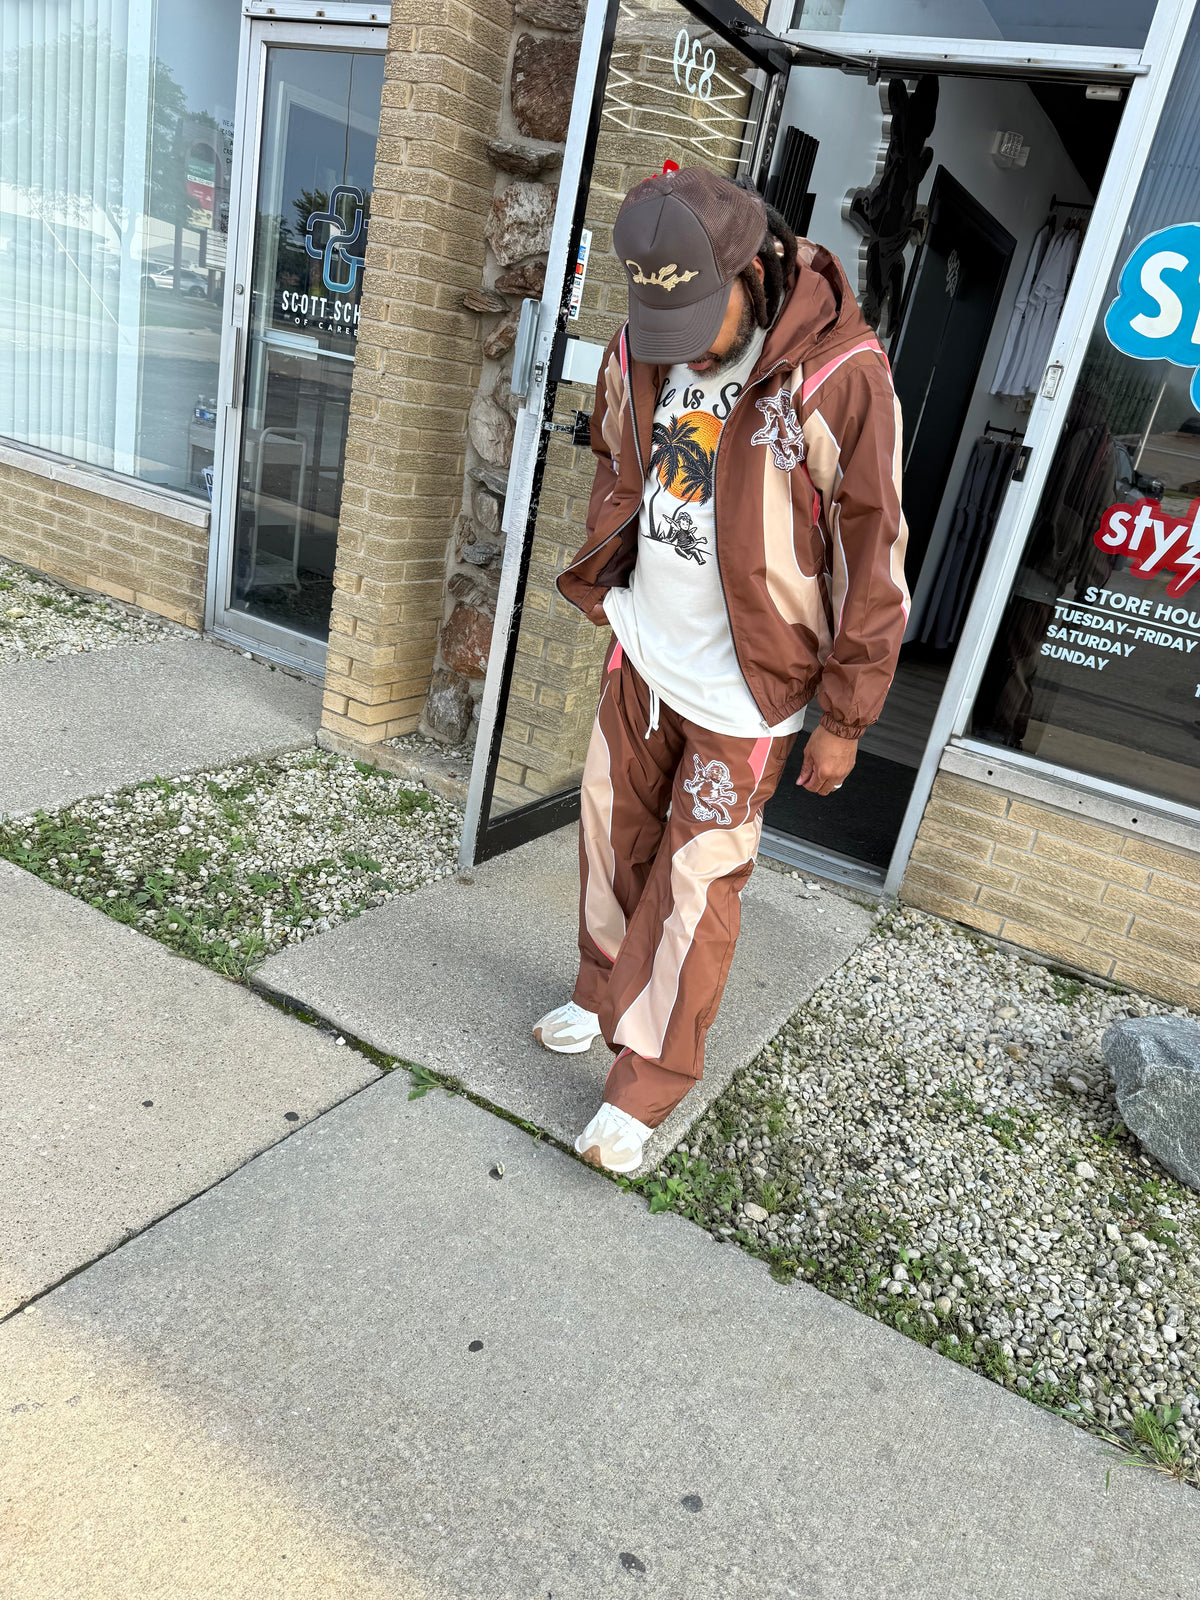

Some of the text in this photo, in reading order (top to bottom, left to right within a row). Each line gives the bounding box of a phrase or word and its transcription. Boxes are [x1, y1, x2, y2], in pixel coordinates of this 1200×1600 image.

[281, 290, 360, 324] SCOTT SCH
[1129, 250, 1200, 345] S
[294, 317, 358, 337] OF CAREE
[682, 383, 705, 410] is
[1084, 586, 1200, 628] STORE HOU
[1046, 624, 1136, 658] SATURDAY
[1054, 605, 1199, 653] TUESDAY-FRIDAY
[1040, 643, 1110, 671] SUNDAY
